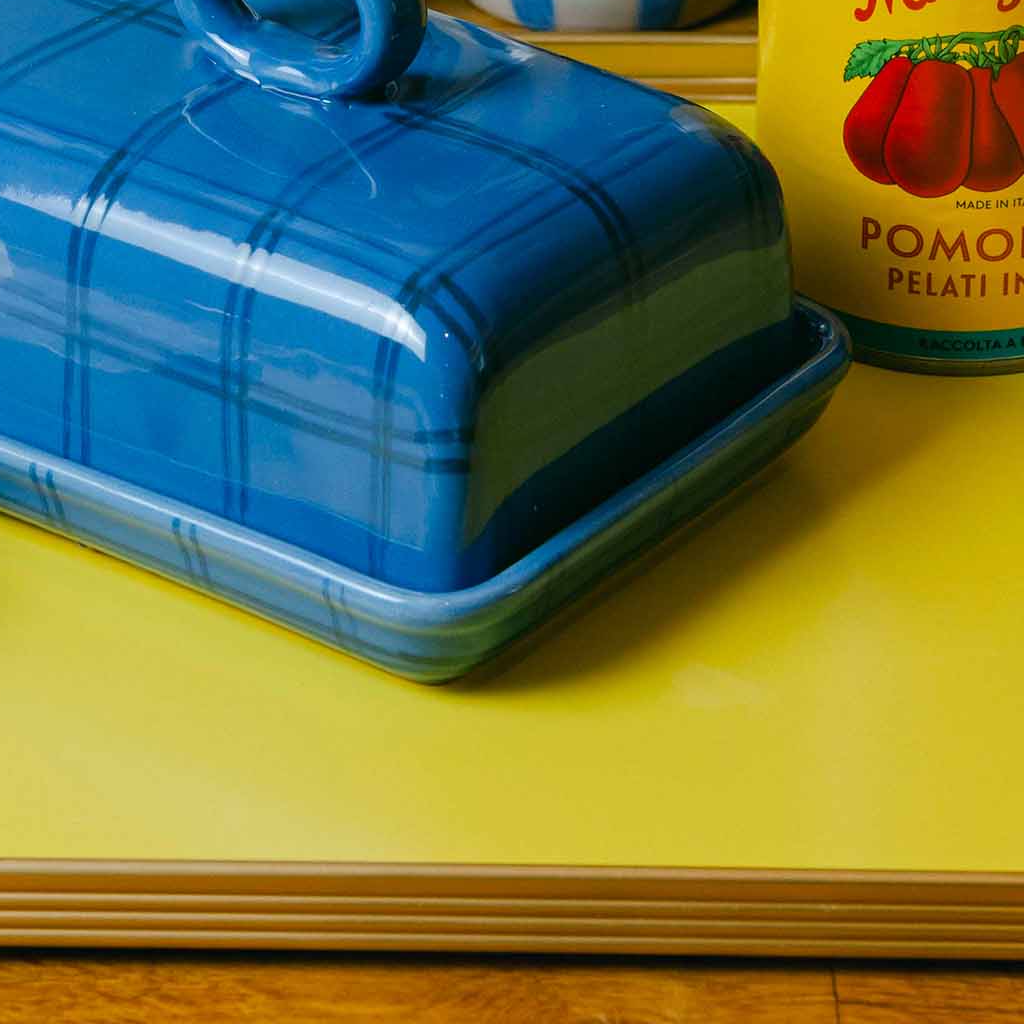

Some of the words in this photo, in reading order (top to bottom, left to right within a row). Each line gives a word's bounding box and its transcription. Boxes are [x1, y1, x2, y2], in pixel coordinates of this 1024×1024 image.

[956, 199, 992, 210] MADE
[995, 199, 1009, 209] IN
[1012, 197, 1024, 209] IT
[861, 216, 1024, 263] POMO
[887, 267, 986, 298] PELATI
[919, 337, 1002, 353] RACCOLTA
[1005, 337, 1017, 349] A
